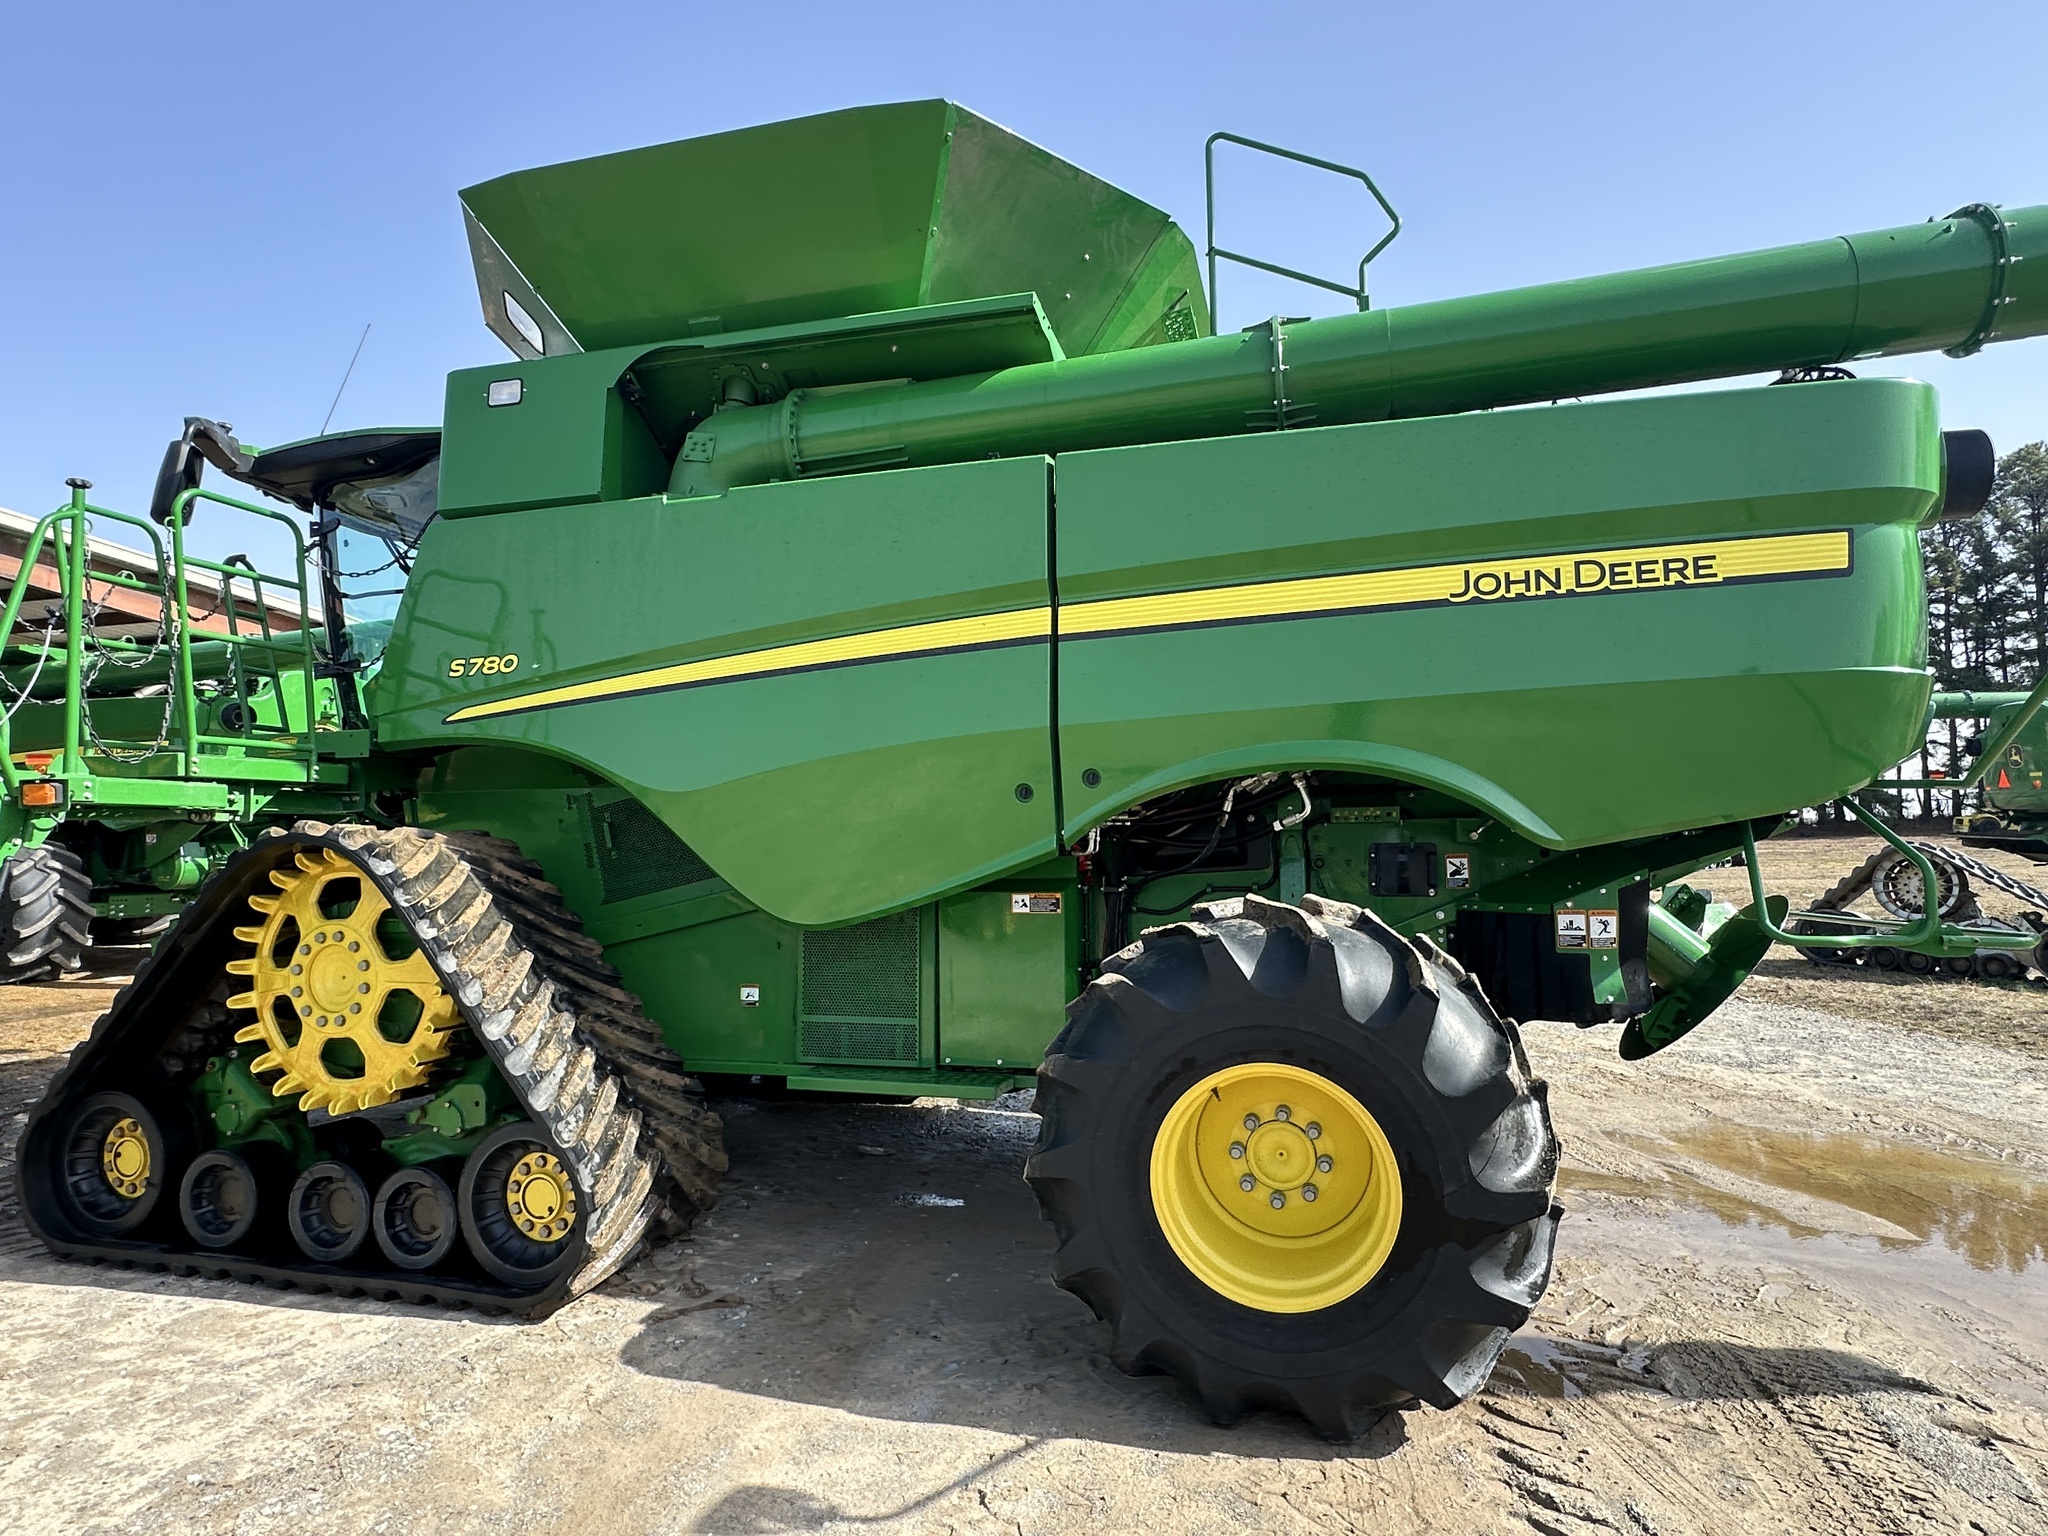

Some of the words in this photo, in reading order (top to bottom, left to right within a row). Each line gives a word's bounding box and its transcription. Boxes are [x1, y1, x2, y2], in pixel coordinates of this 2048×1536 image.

[1449, 567, 1561, 598] JOHN
[1574, 555, 1718, 589] DEERE
[448, 653, 519, 678] S780
